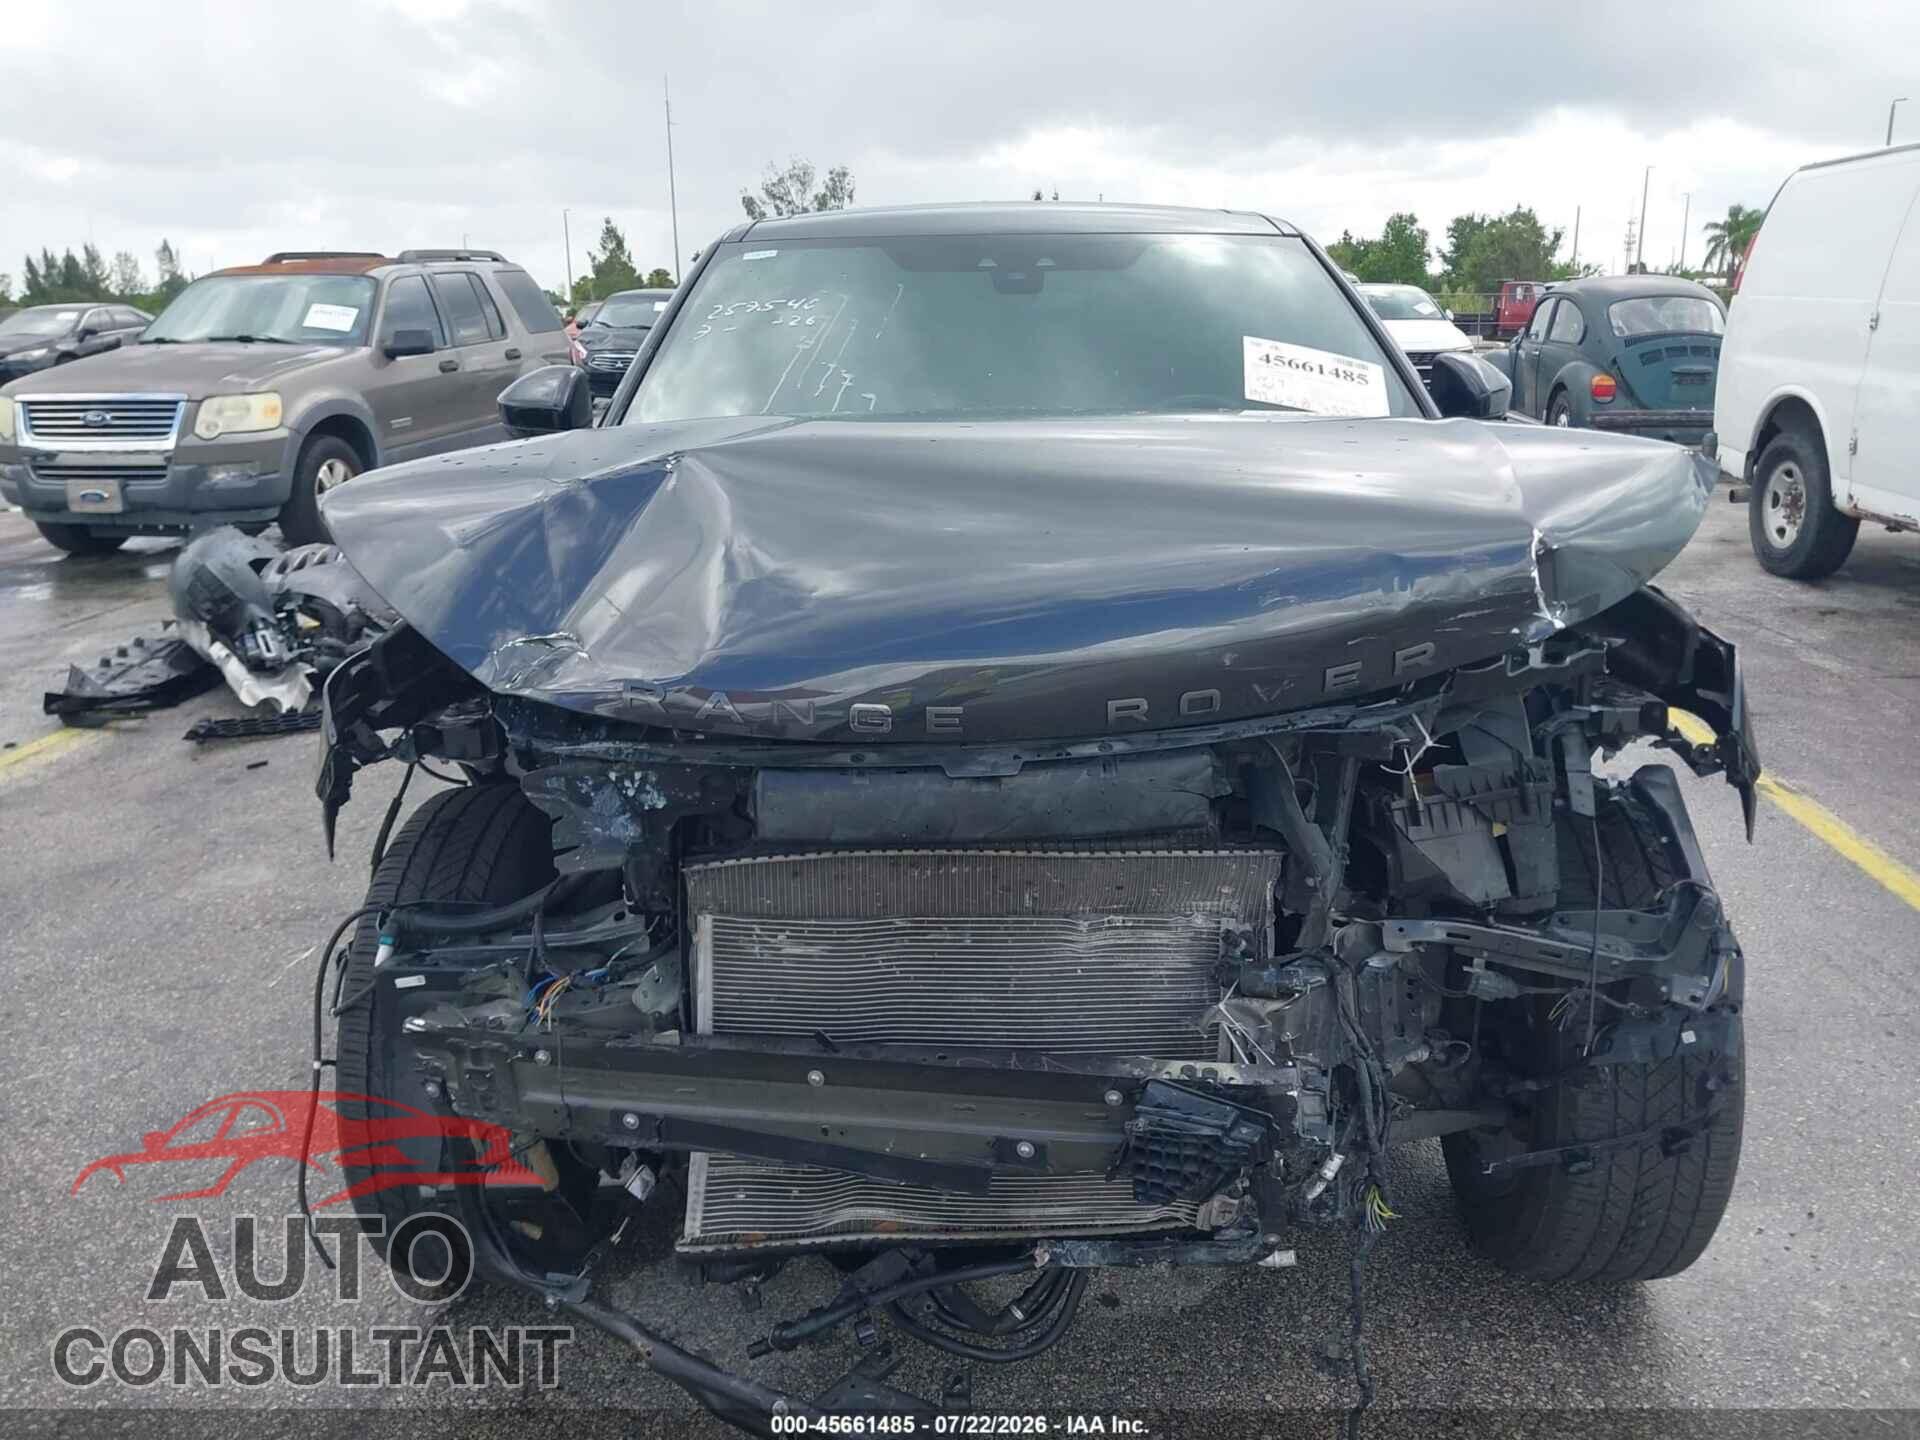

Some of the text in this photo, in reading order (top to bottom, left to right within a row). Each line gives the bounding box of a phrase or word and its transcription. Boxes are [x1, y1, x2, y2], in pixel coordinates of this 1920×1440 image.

[1258, 352, 1370, 386] 45661485
[620, 641, 1437, 735] RANGE ROVER
